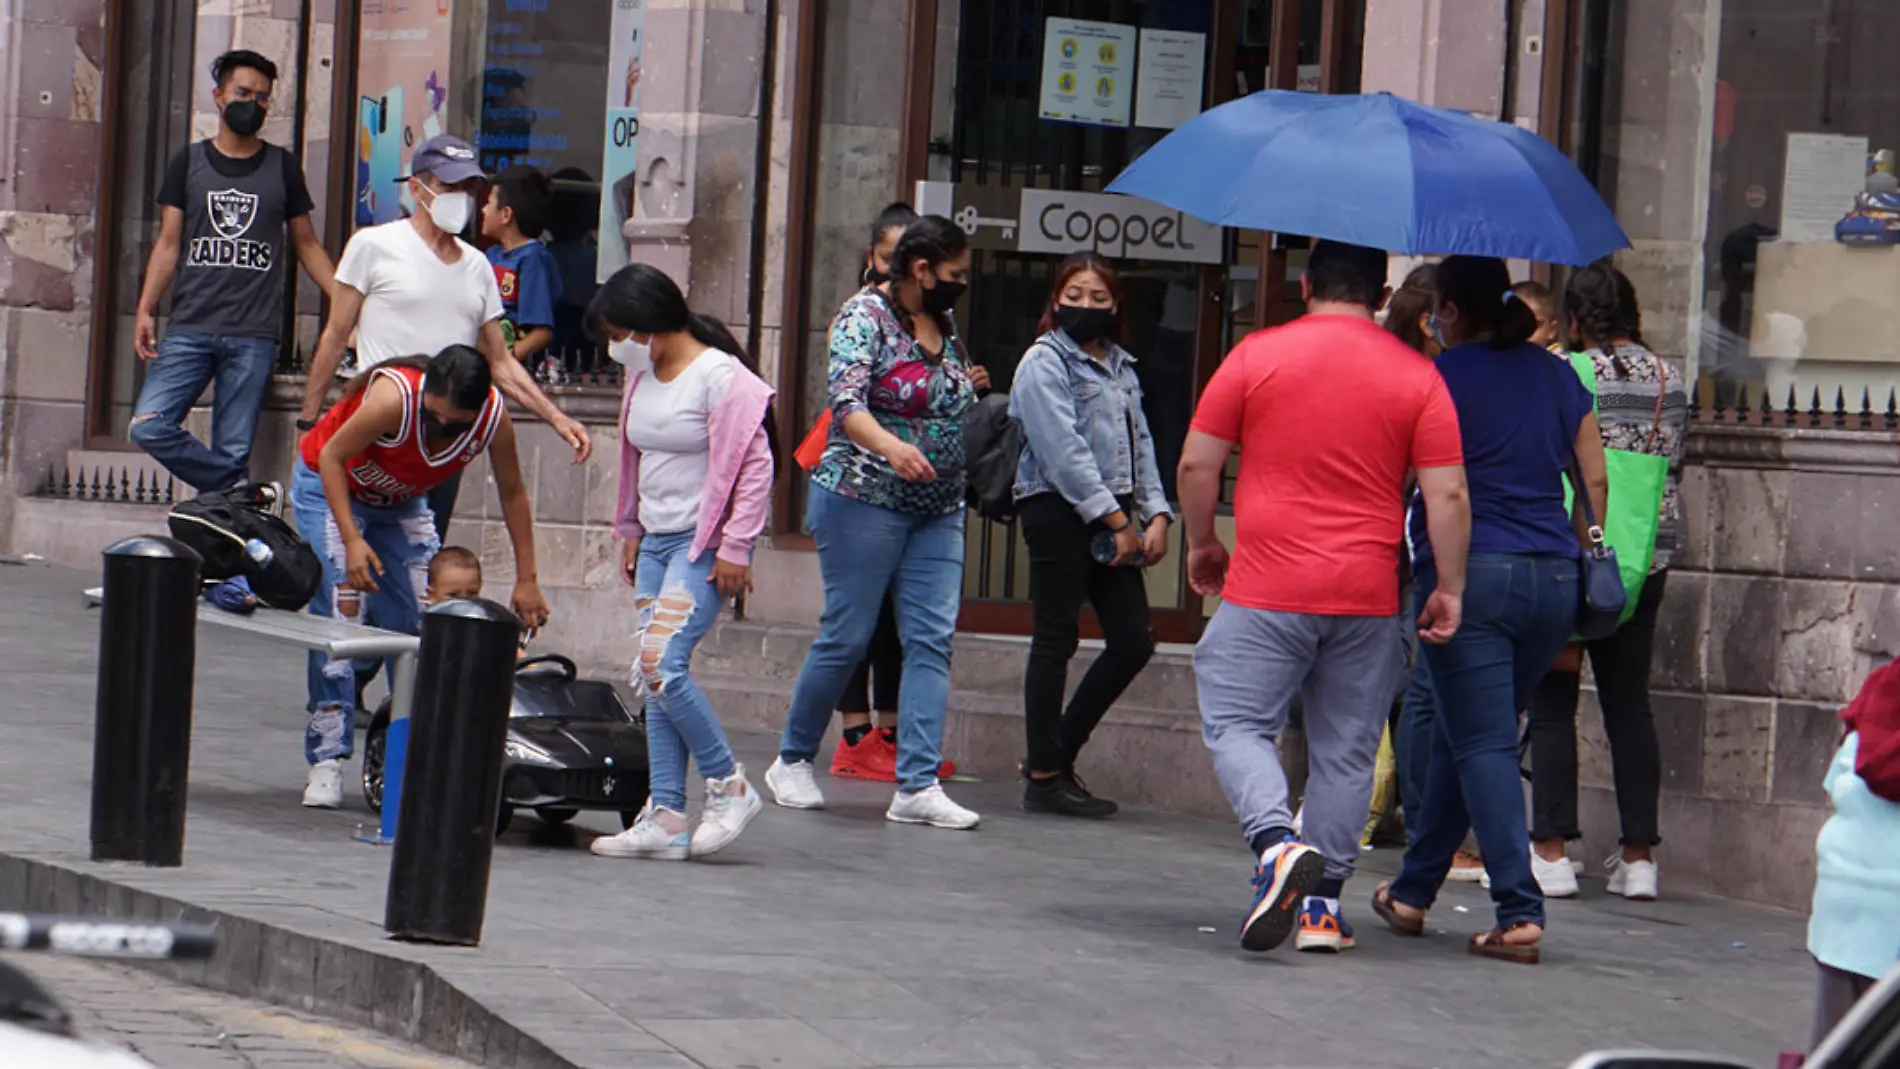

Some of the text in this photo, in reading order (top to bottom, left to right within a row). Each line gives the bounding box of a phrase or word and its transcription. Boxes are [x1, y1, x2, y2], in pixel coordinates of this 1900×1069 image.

[613, 116, 639, 147] OP
[1039, 202, 1195, 259] Coppel
[187, 237, 272, 271] RAIDERS
